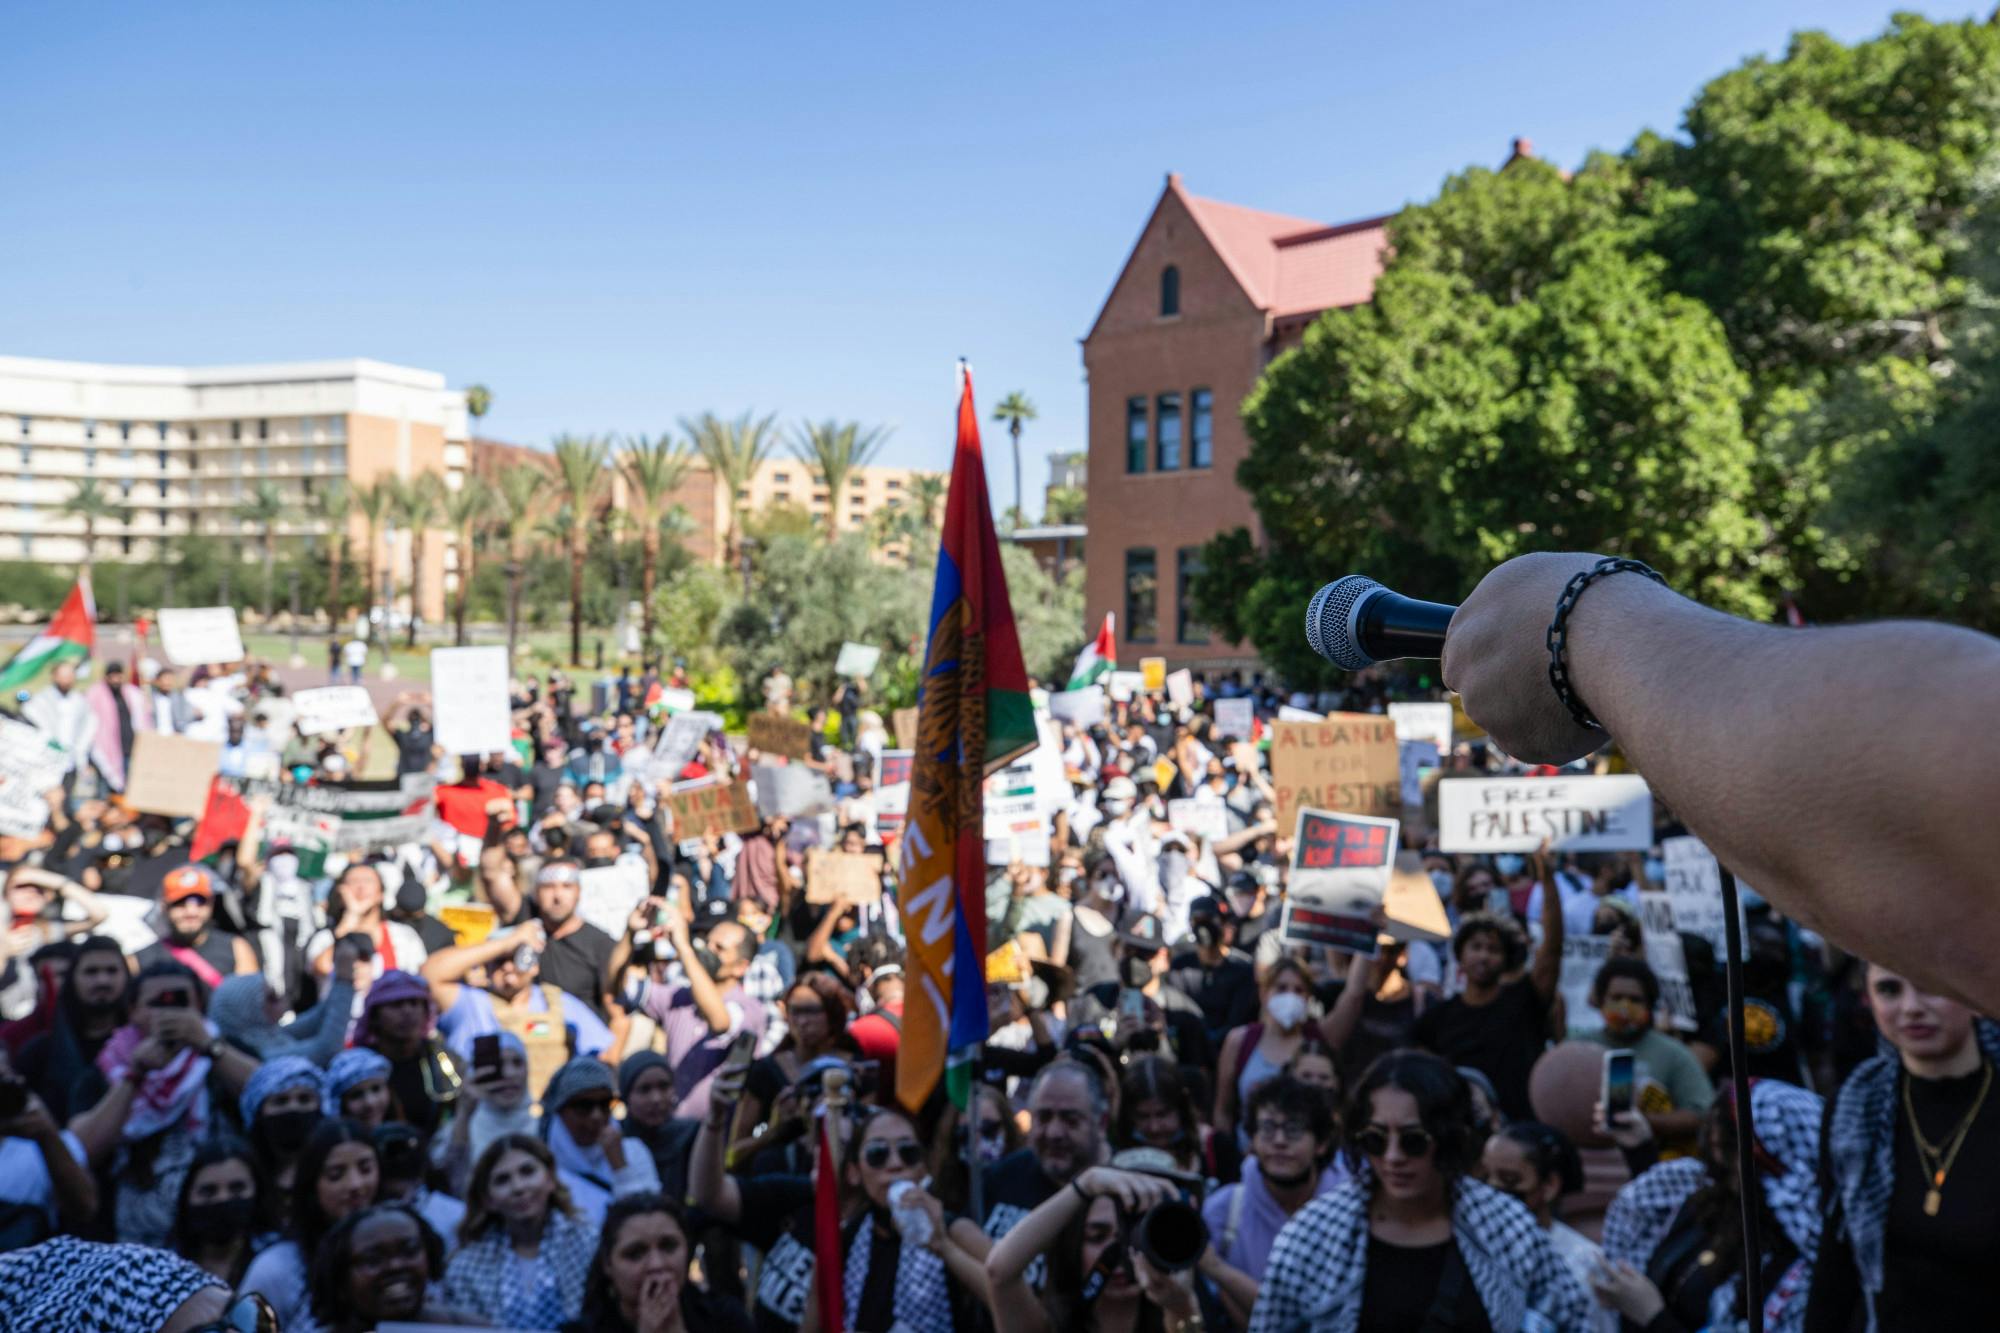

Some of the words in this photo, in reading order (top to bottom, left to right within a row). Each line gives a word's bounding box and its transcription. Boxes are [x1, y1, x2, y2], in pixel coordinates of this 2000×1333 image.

[1280, 723, 1395, 750] ALBANIA
[1313, 754, 1364, 775] FOR
[1276, 782, 1400, 814] PALESTINE
[1482, 783, 1569, 805] FREE
[1469, 806, 1628, 841] PALESTINE
